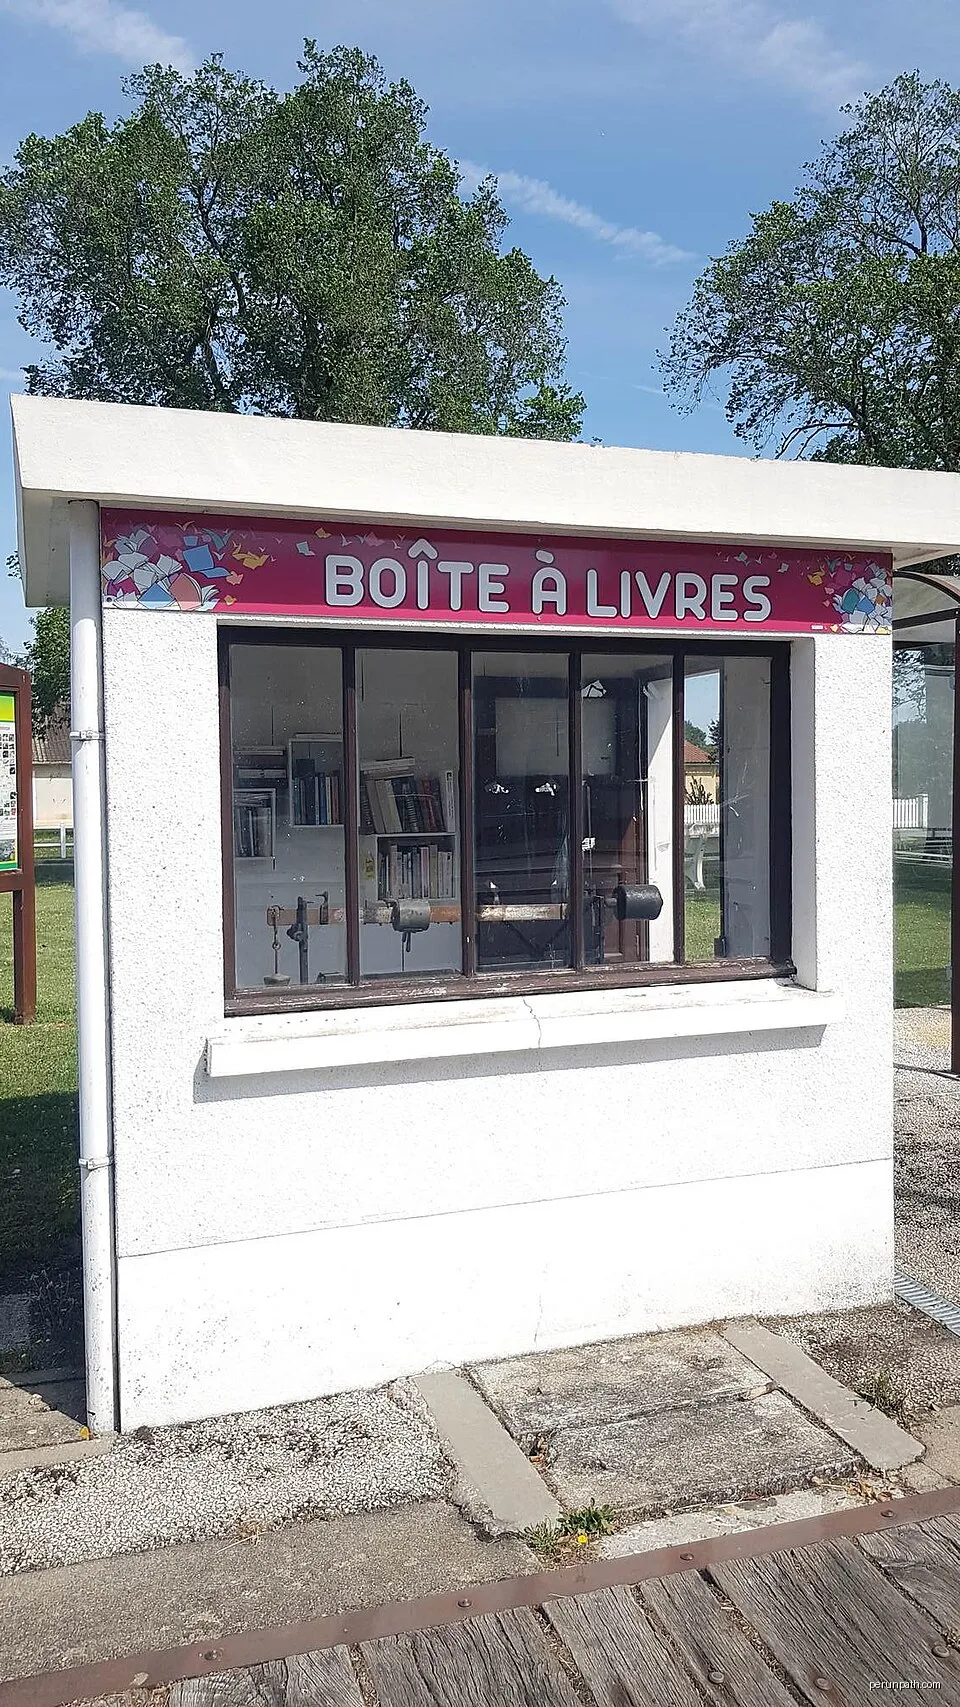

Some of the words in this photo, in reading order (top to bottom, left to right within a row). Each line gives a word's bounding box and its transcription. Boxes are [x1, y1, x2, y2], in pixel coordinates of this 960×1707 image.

[325, 538, 509, 612] BOÎTE
[532, 549, 567, 615] À
[586, 568, 772, 623] LIVRES
